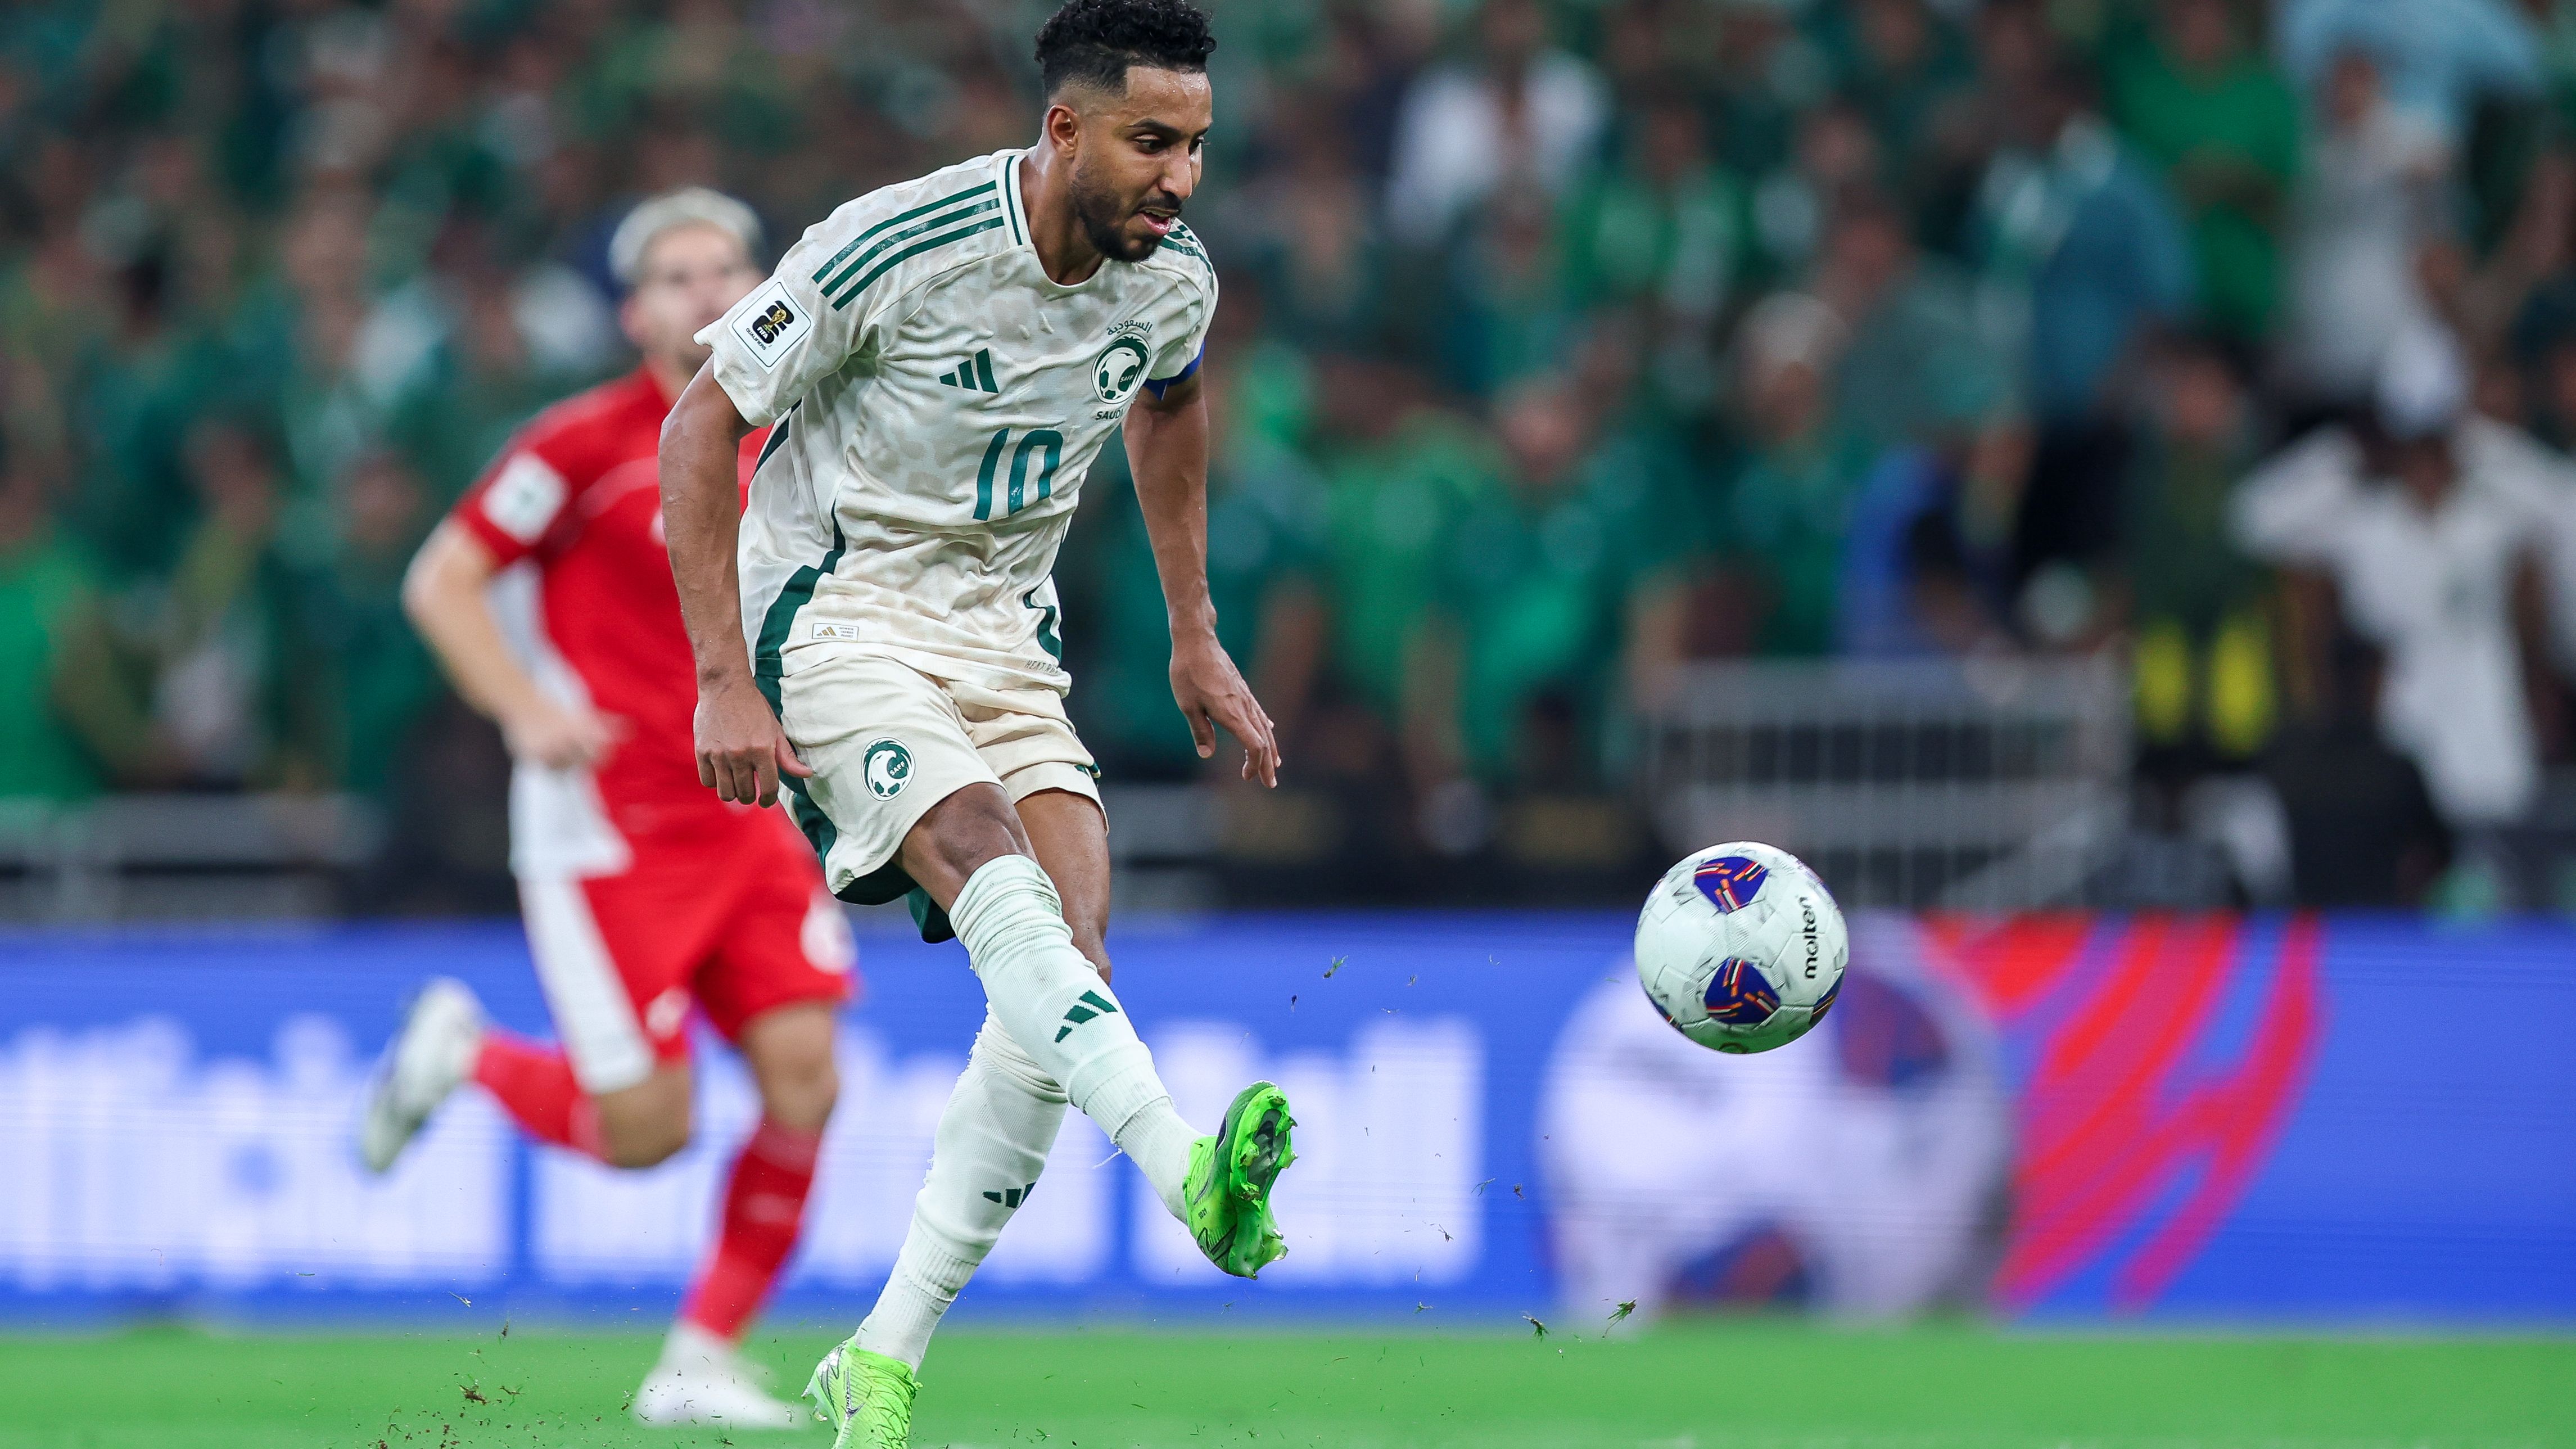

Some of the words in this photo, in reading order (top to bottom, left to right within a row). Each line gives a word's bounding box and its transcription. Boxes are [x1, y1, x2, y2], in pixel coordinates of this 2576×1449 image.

[757, 326, 769, 339] FIFA
[1106, 320, 1153, 335] السعودية
[745, 328, 766, 350] QUALIFIERS
[1095, 409, 1123, 421] SAUDI
[973, 427, 1064, 521] 10
[889, 761, 905, 776] SAFF
[1799, 896, 1819, 979] molten
